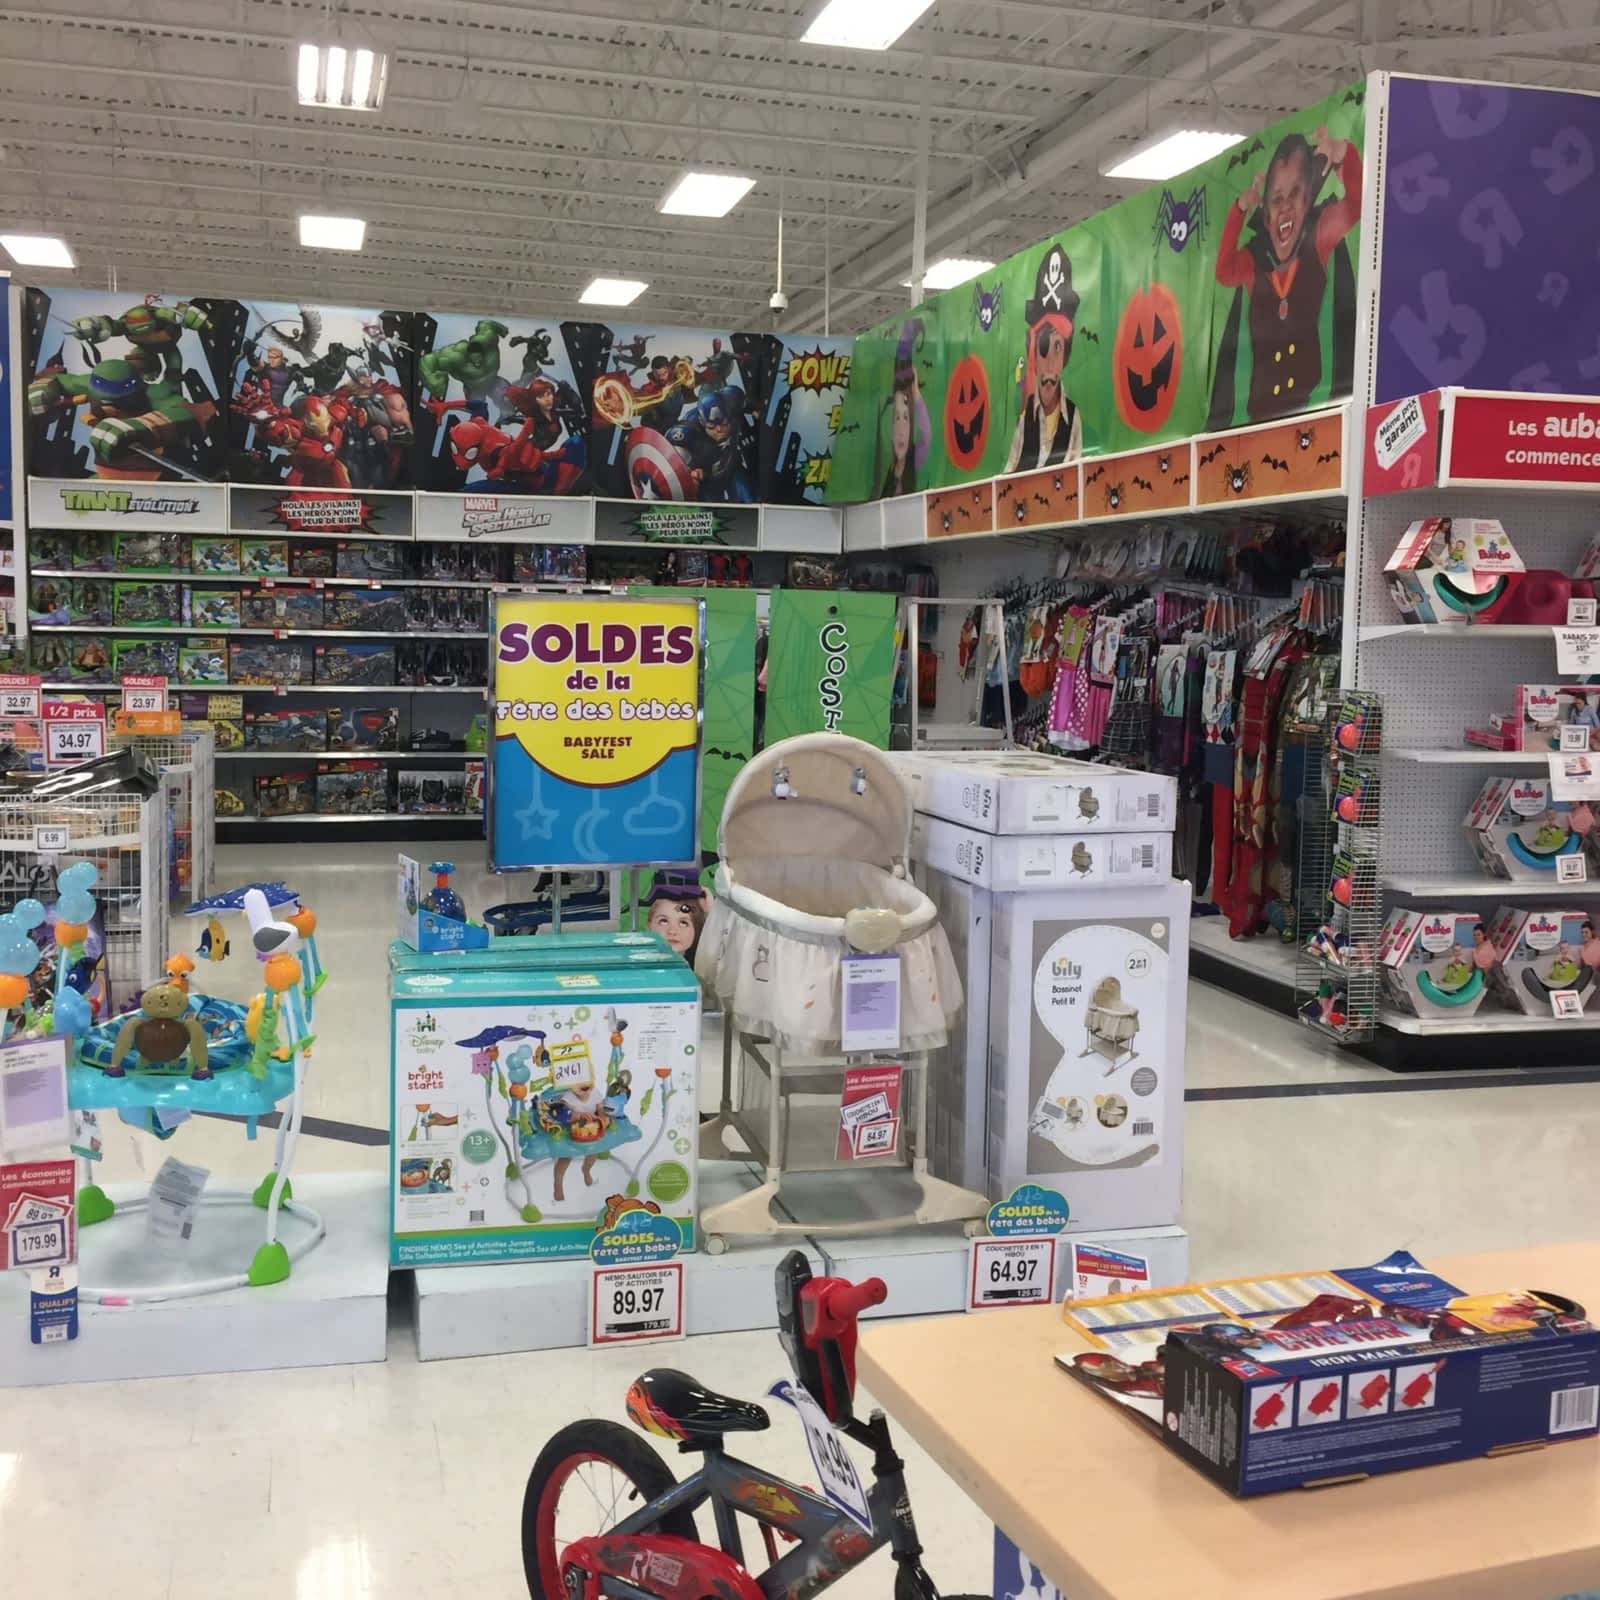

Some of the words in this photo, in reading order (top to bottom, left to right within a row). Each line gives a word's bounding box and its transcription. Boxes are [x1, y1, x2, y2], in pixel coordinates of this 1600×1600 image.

[788, 356, 848, 385] POW!
[1402, 397, 1417, 418] prix
[1385, 404, 1419, 452] garanti
[1508, 420, 1538, 437] Les
[127, 499, 193, 513] EVOLUTION
[465, 498, 497, 510] MARVEL
[498, 622, 694, 664] SOLDES
[566, 670, 598, 690] de
[606, 670, 630, 690] la
[819, 622, 849, 733] COST
[7, 697, 31, 707] 32.97
[132, 698, 155, 708] 23.97
[50, 706, 69, 716] 1/2
[73, 708, 97, 719] prix
[565, 698, 613, 721] des
[59, 733, 91, 748] 34.97
[564, 737, 632, 748] BABYFEST
[581, 748, 615, 759] SALE
[44, 833, 59, 843] 6.99
[408, 1070, 443, 1083] bright
[408, 1080, 444, 1090] starts
[469, 1135, 490, 1146] 13+
[2, 1173, 17, 1181] Les
[22, 1168, 72, 1179] économies
[998, 1205, 1045, 1218] SOLDES
[1016, 1216, 1034, 1226] des
[22, 1233, 57, 1252] 179.99
[603, 1232, 654, 1247] SOLDES
[622, 1244, 642, 1254] des
[990, 1259, 1038, 1282] 64.97
[613, 1287, 664, 1315] 89.97
[1310, 1353, 1357, 1367] IRON
[1357, 1348, 1400, 1361] MAN
